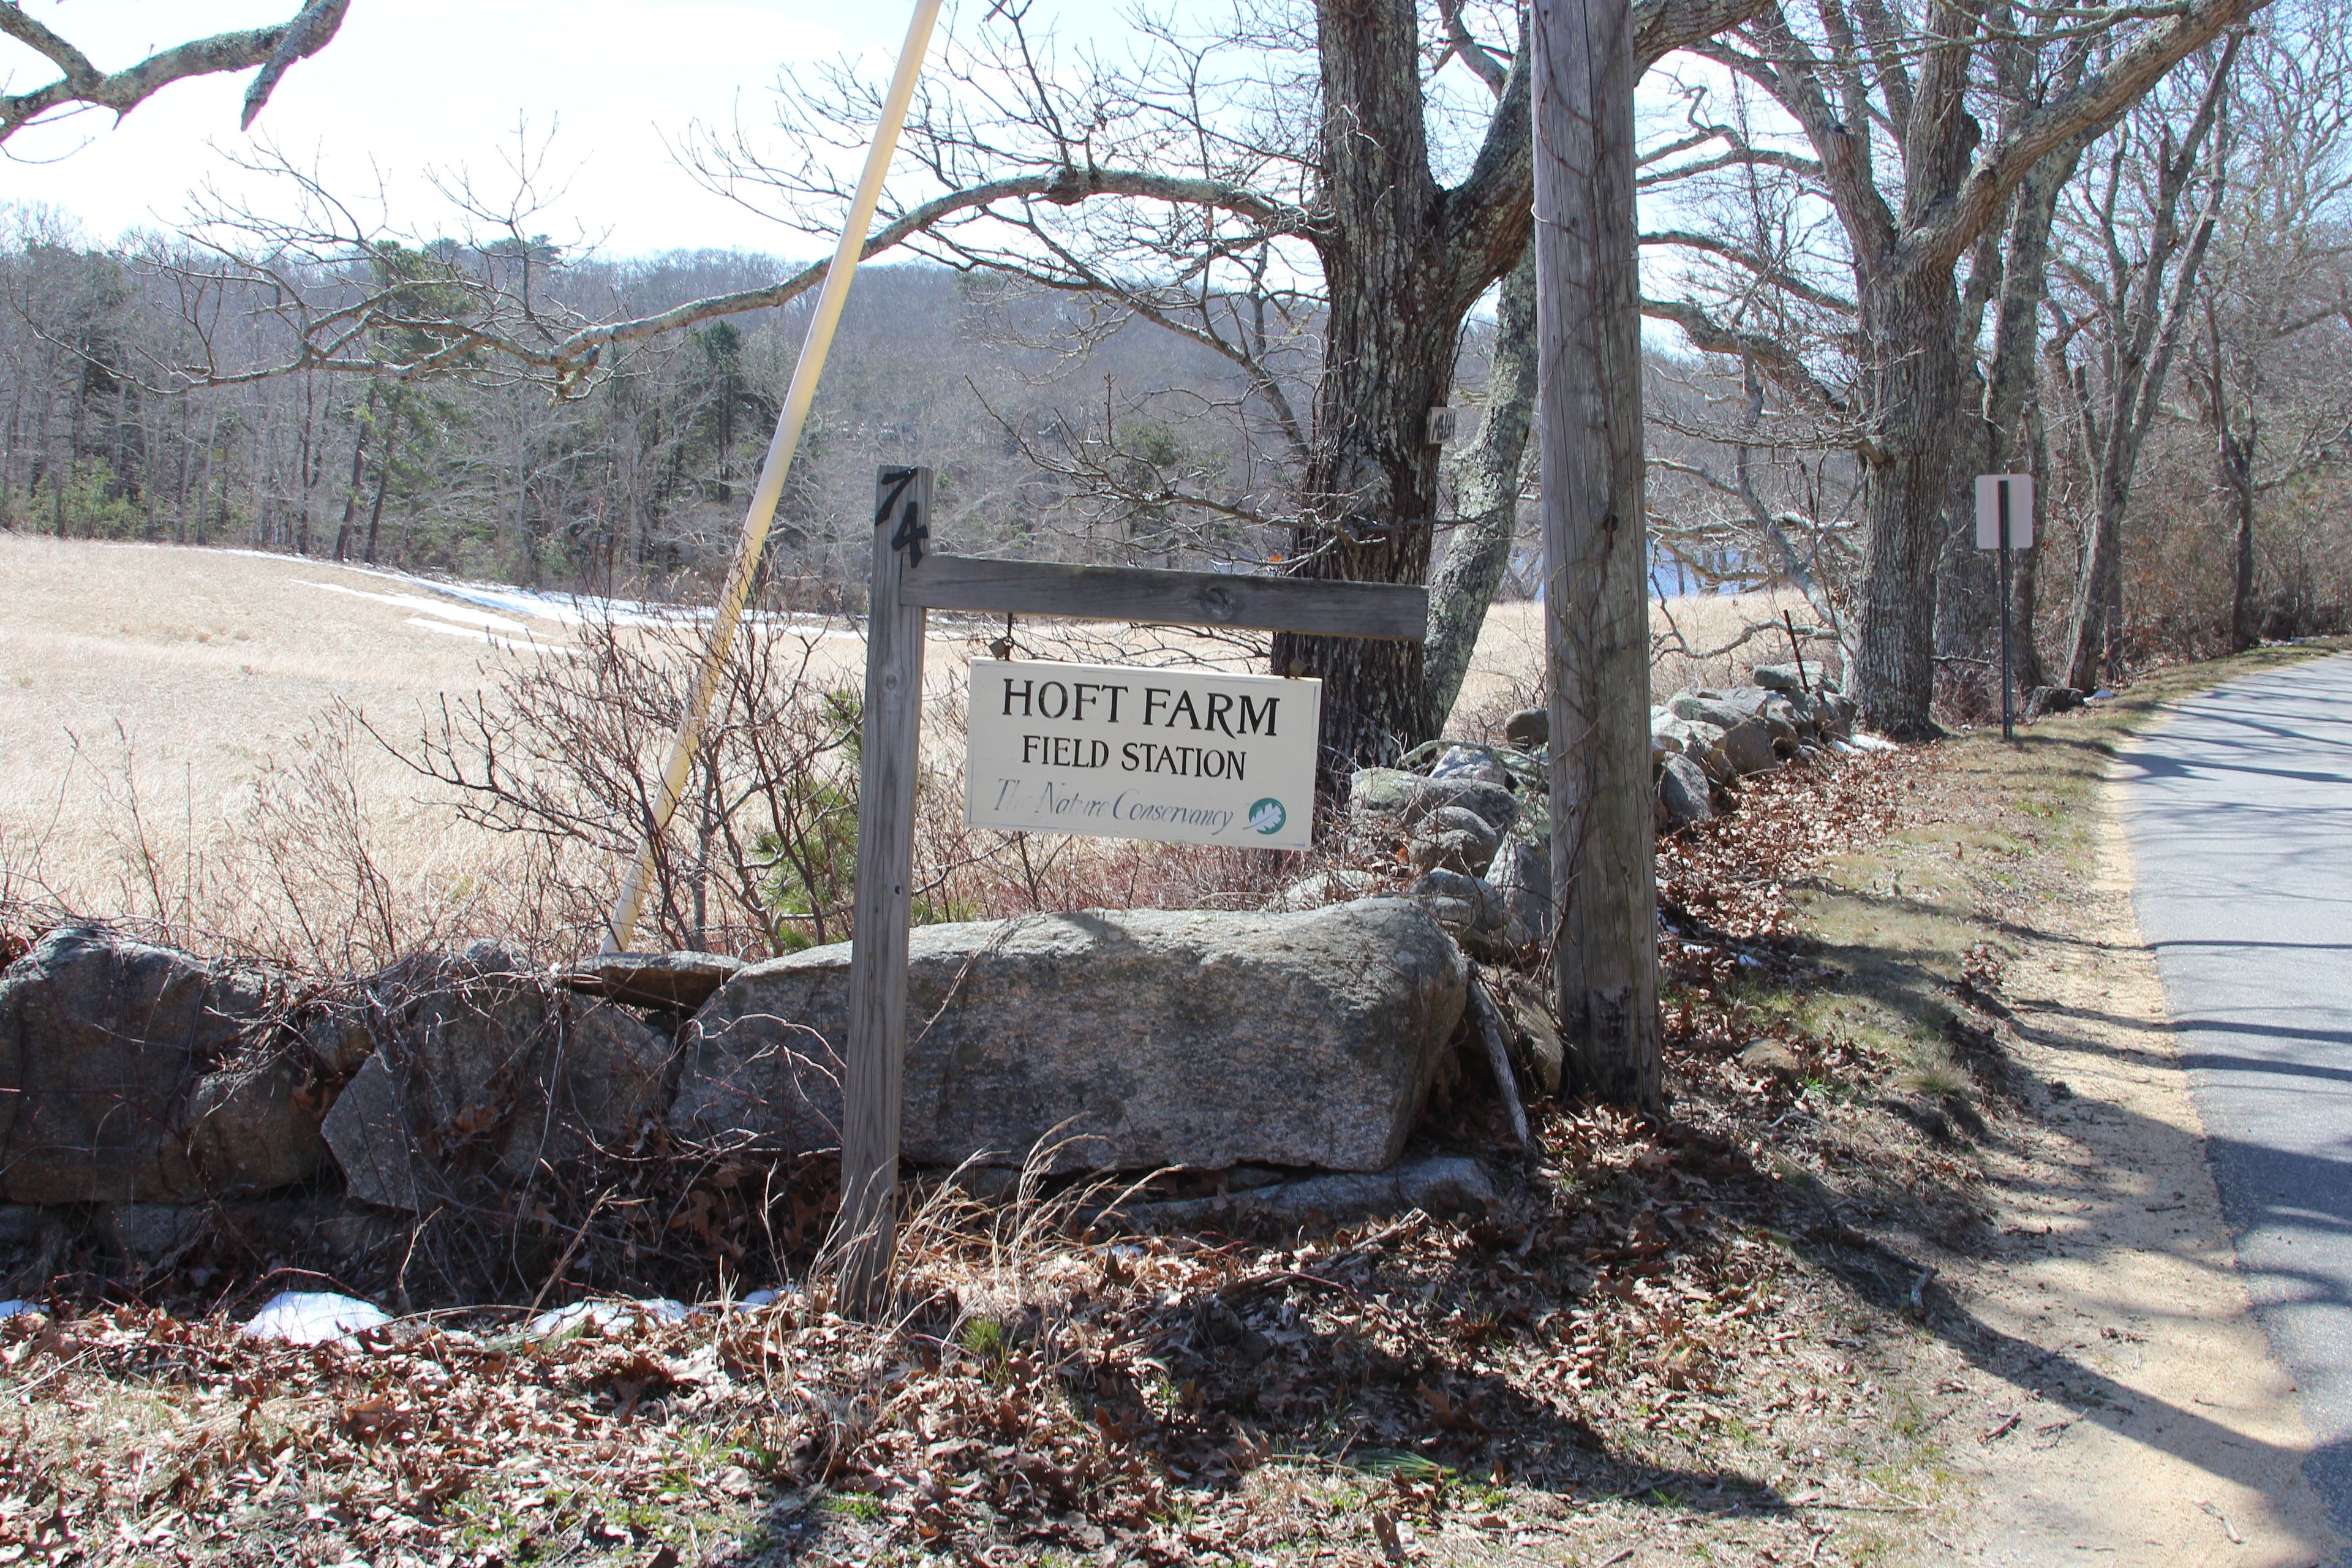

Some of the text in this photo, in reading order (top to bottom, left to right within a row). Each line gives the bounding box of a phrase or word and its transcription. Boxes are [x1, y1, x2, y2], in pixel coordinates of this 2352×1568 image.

[875, 466, 929, 568] 74
[1002, 678, 1280, 740] HOFT FARM
[1022, 735, 1246, 781] FIELD STATION
[993, 778, 1029, 812] Th
[1112, 788, 1234, 835] Conservancy
